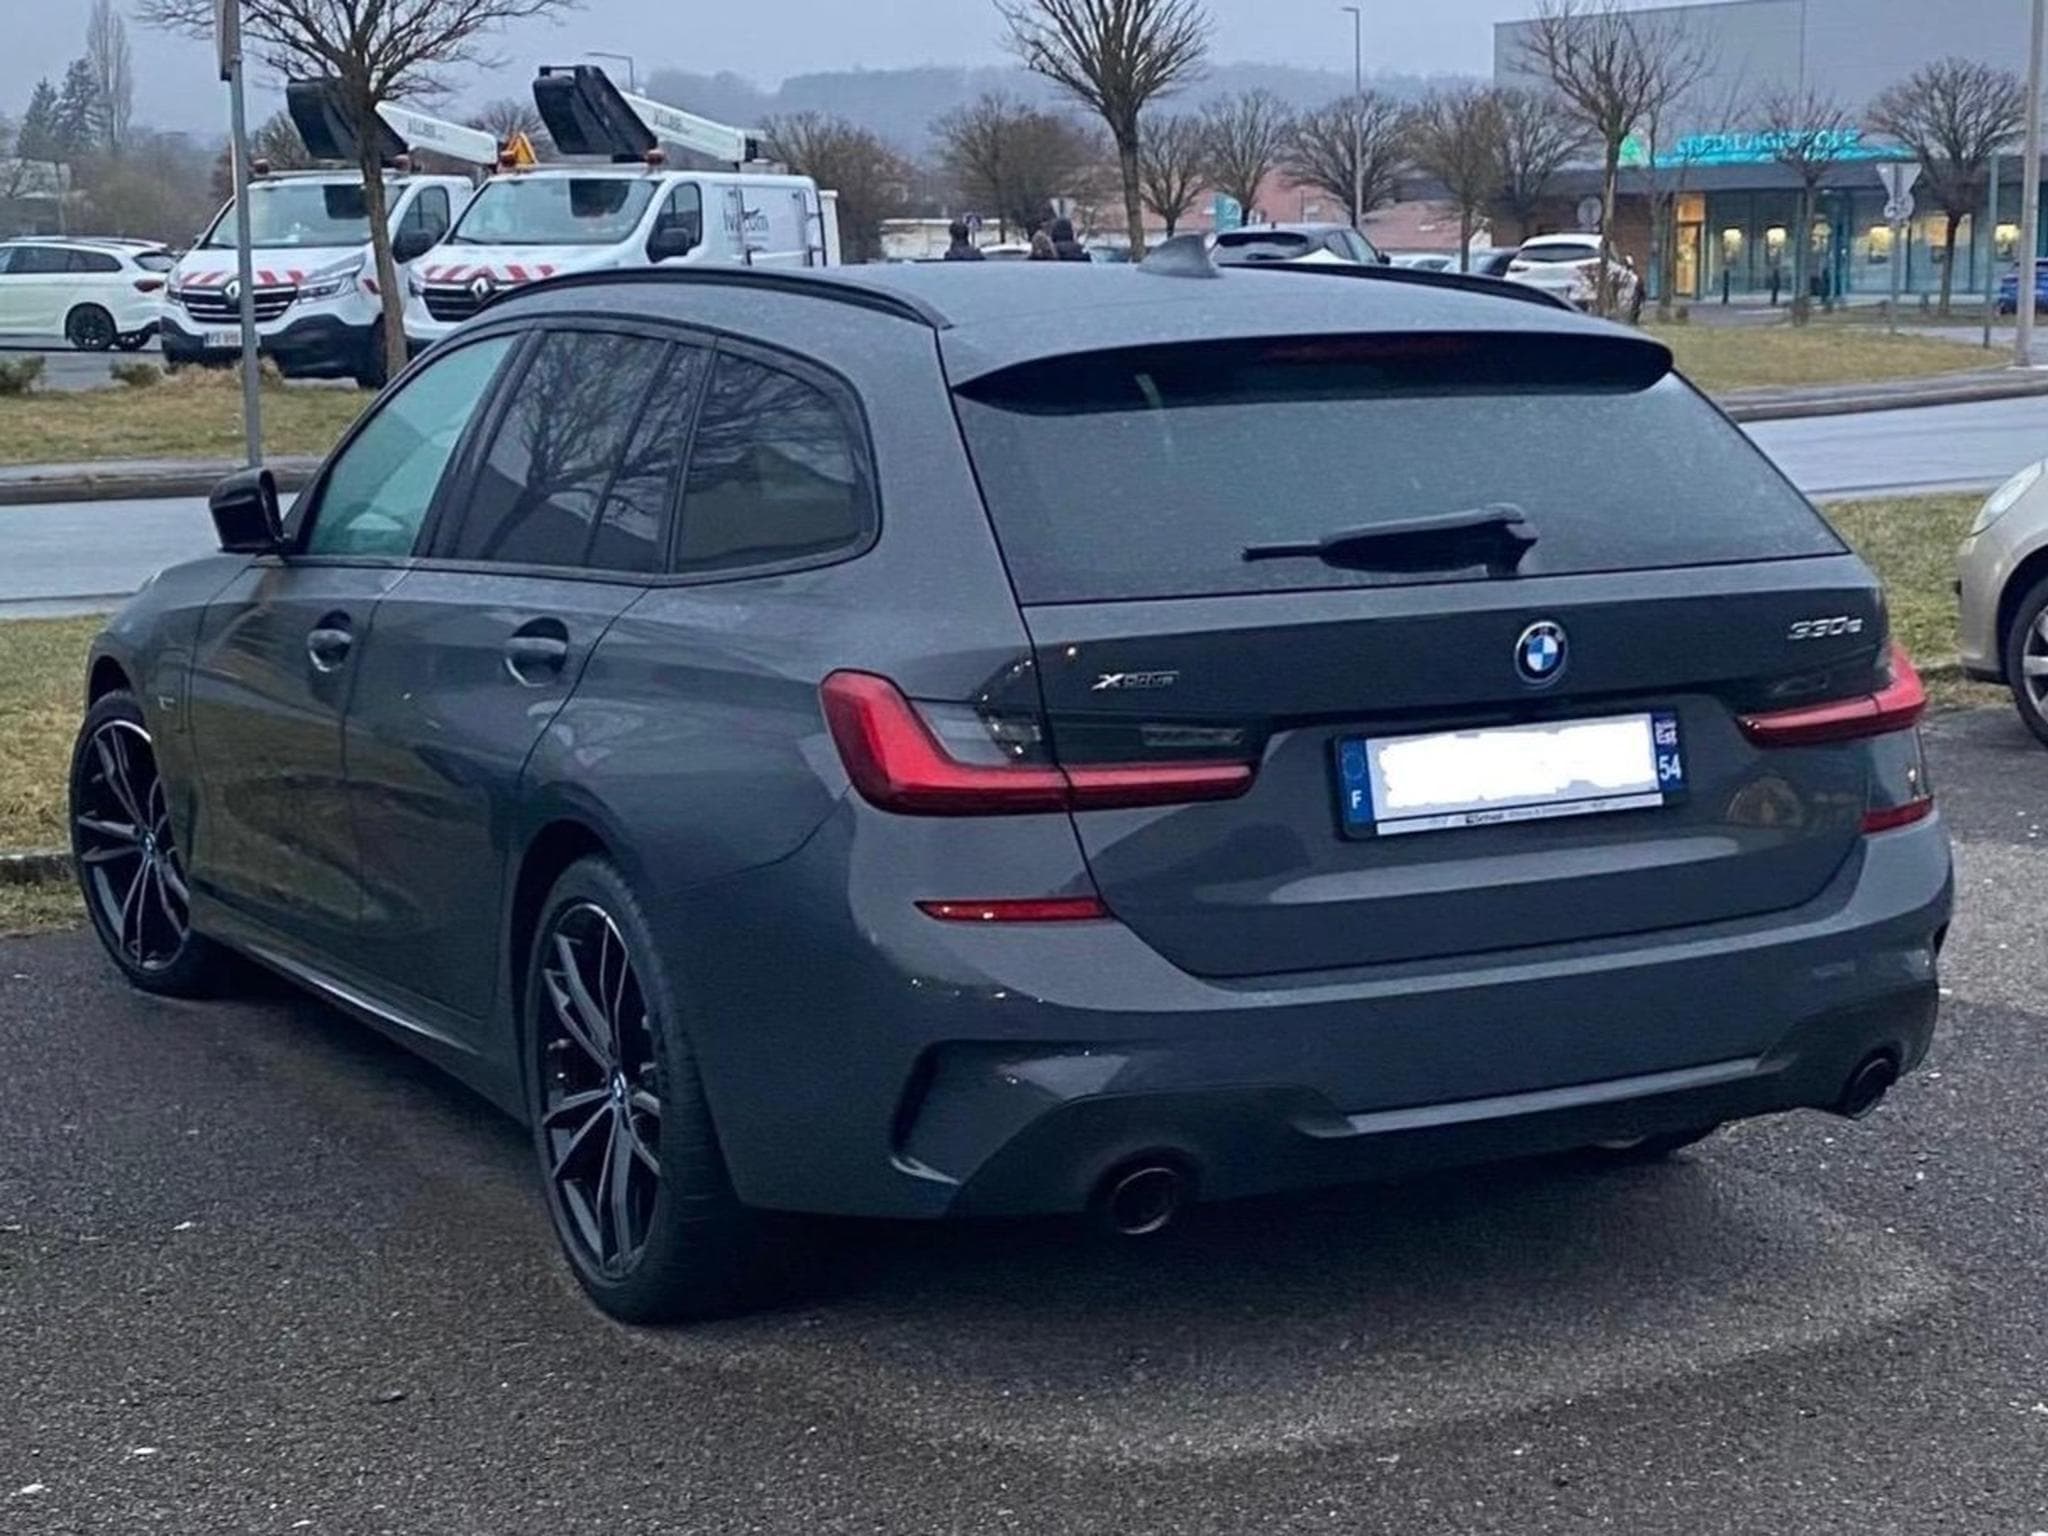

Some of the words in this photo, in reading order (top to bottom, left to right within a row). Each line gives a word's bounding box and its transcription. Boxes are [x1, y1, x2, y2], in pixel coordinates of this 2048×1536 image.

[1787, 616, 1862, 640] 330e
[1659, 753, 1682, 781] 54
[1351, 790, 1362, 809] F
